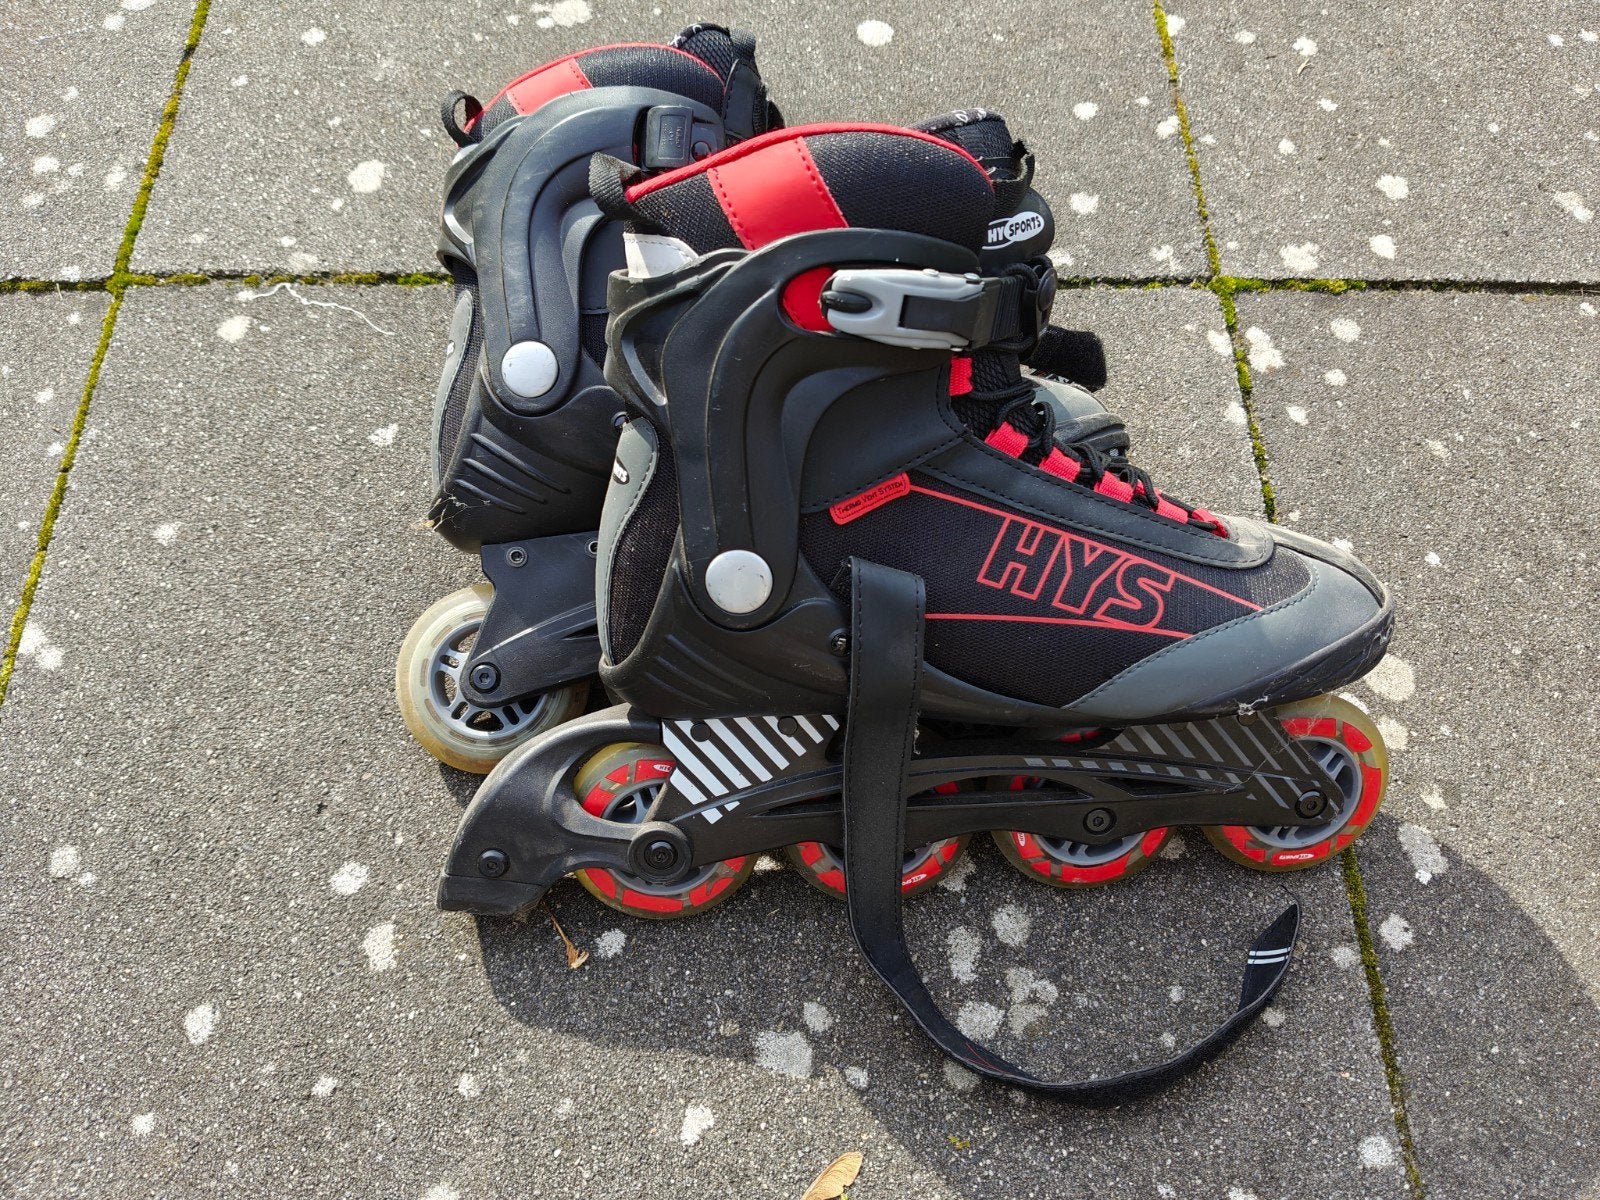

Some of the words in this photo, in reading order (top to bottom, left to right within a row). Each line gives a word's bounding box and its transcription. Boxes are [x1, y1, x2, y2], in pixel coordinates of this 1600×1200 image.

[987, 226, 1005, 243] HY
[1009, 216, 1042, 237] SPORTS
[976, 515, 1176, 630] HYS
